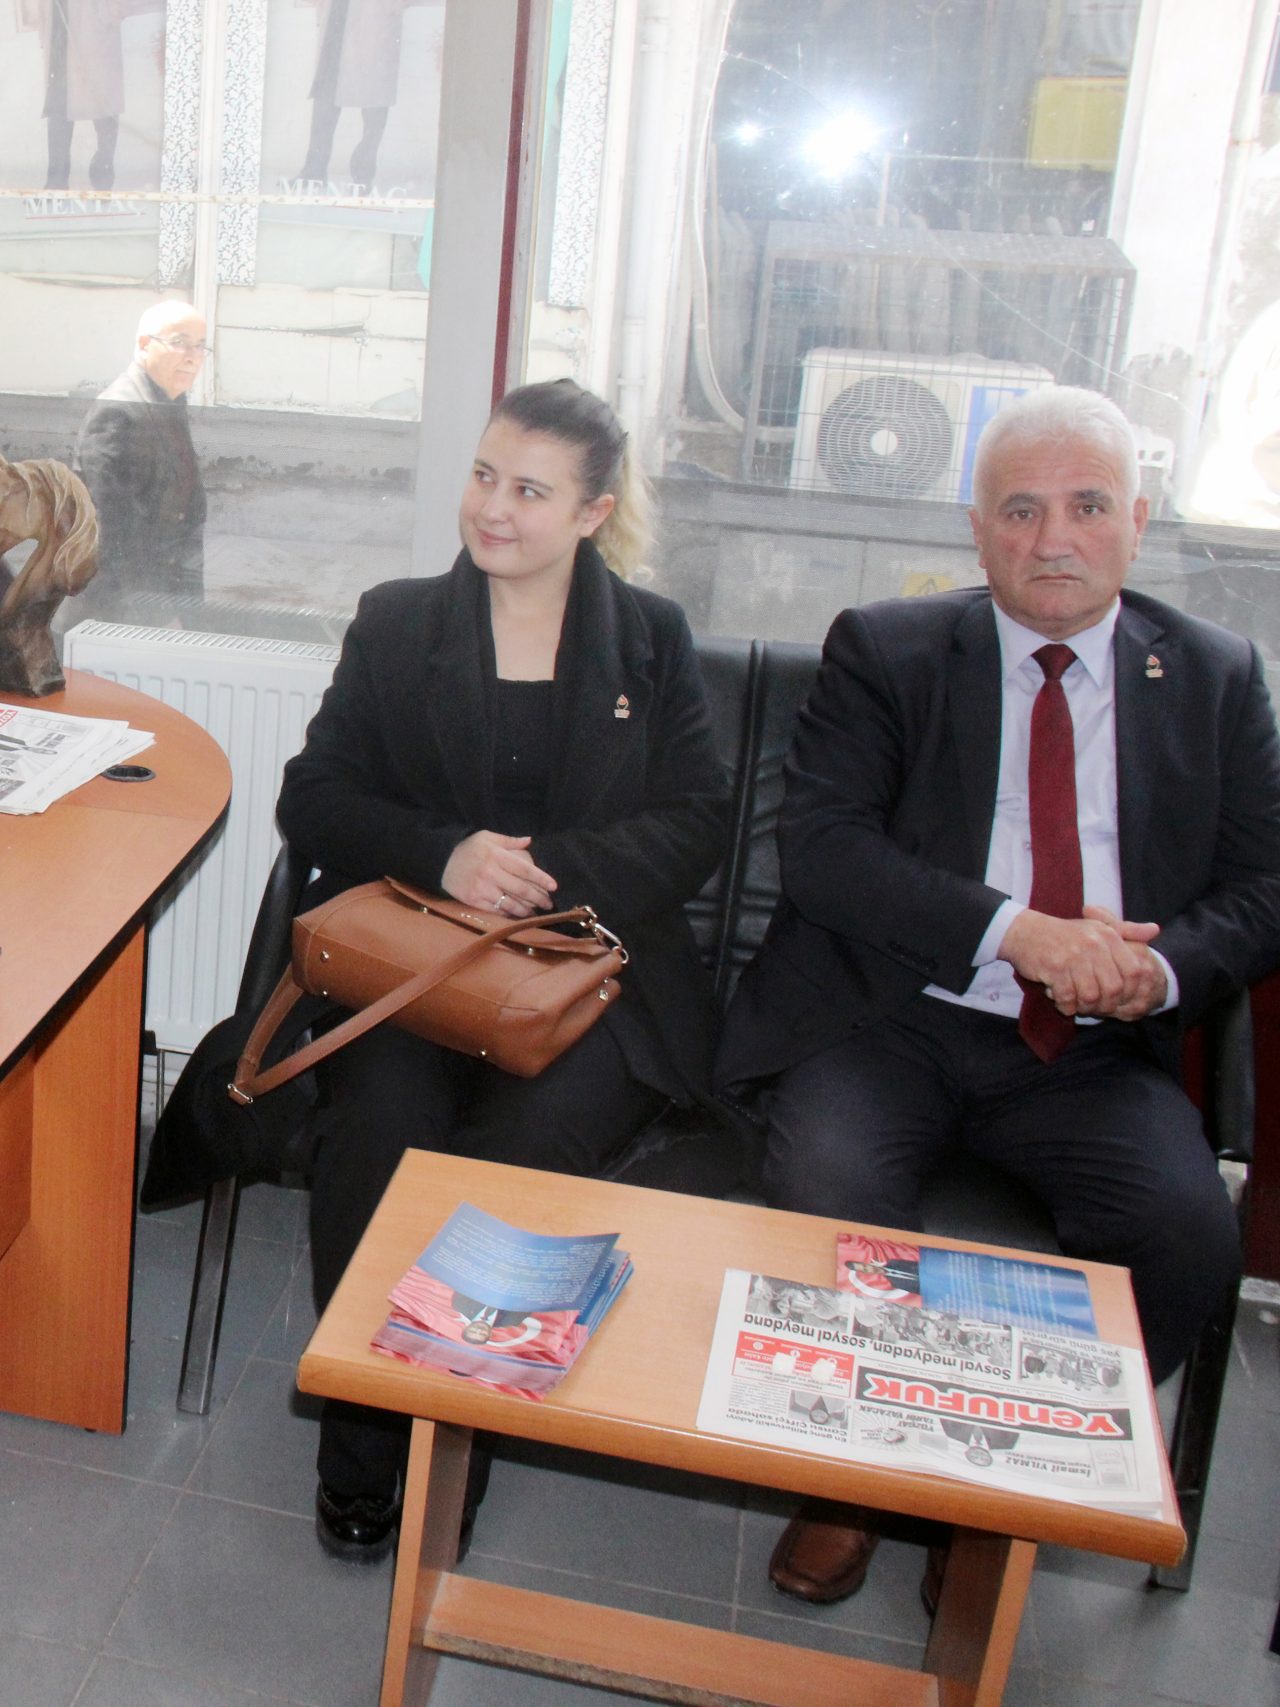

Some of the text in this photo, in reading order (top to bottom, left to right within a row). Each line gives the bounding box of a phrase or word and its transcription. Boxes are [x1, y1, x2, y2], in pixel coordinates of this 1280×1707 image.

[743, 1314, 815, 1339] meydana
[817, 1329, 866, 1349] sosyal
[869, 1339, 958, 1369] medyadan,
[960, 1360, 1012, 1381] Sosyal
[1005, 1455, 1049, 1470] YILMAZ
